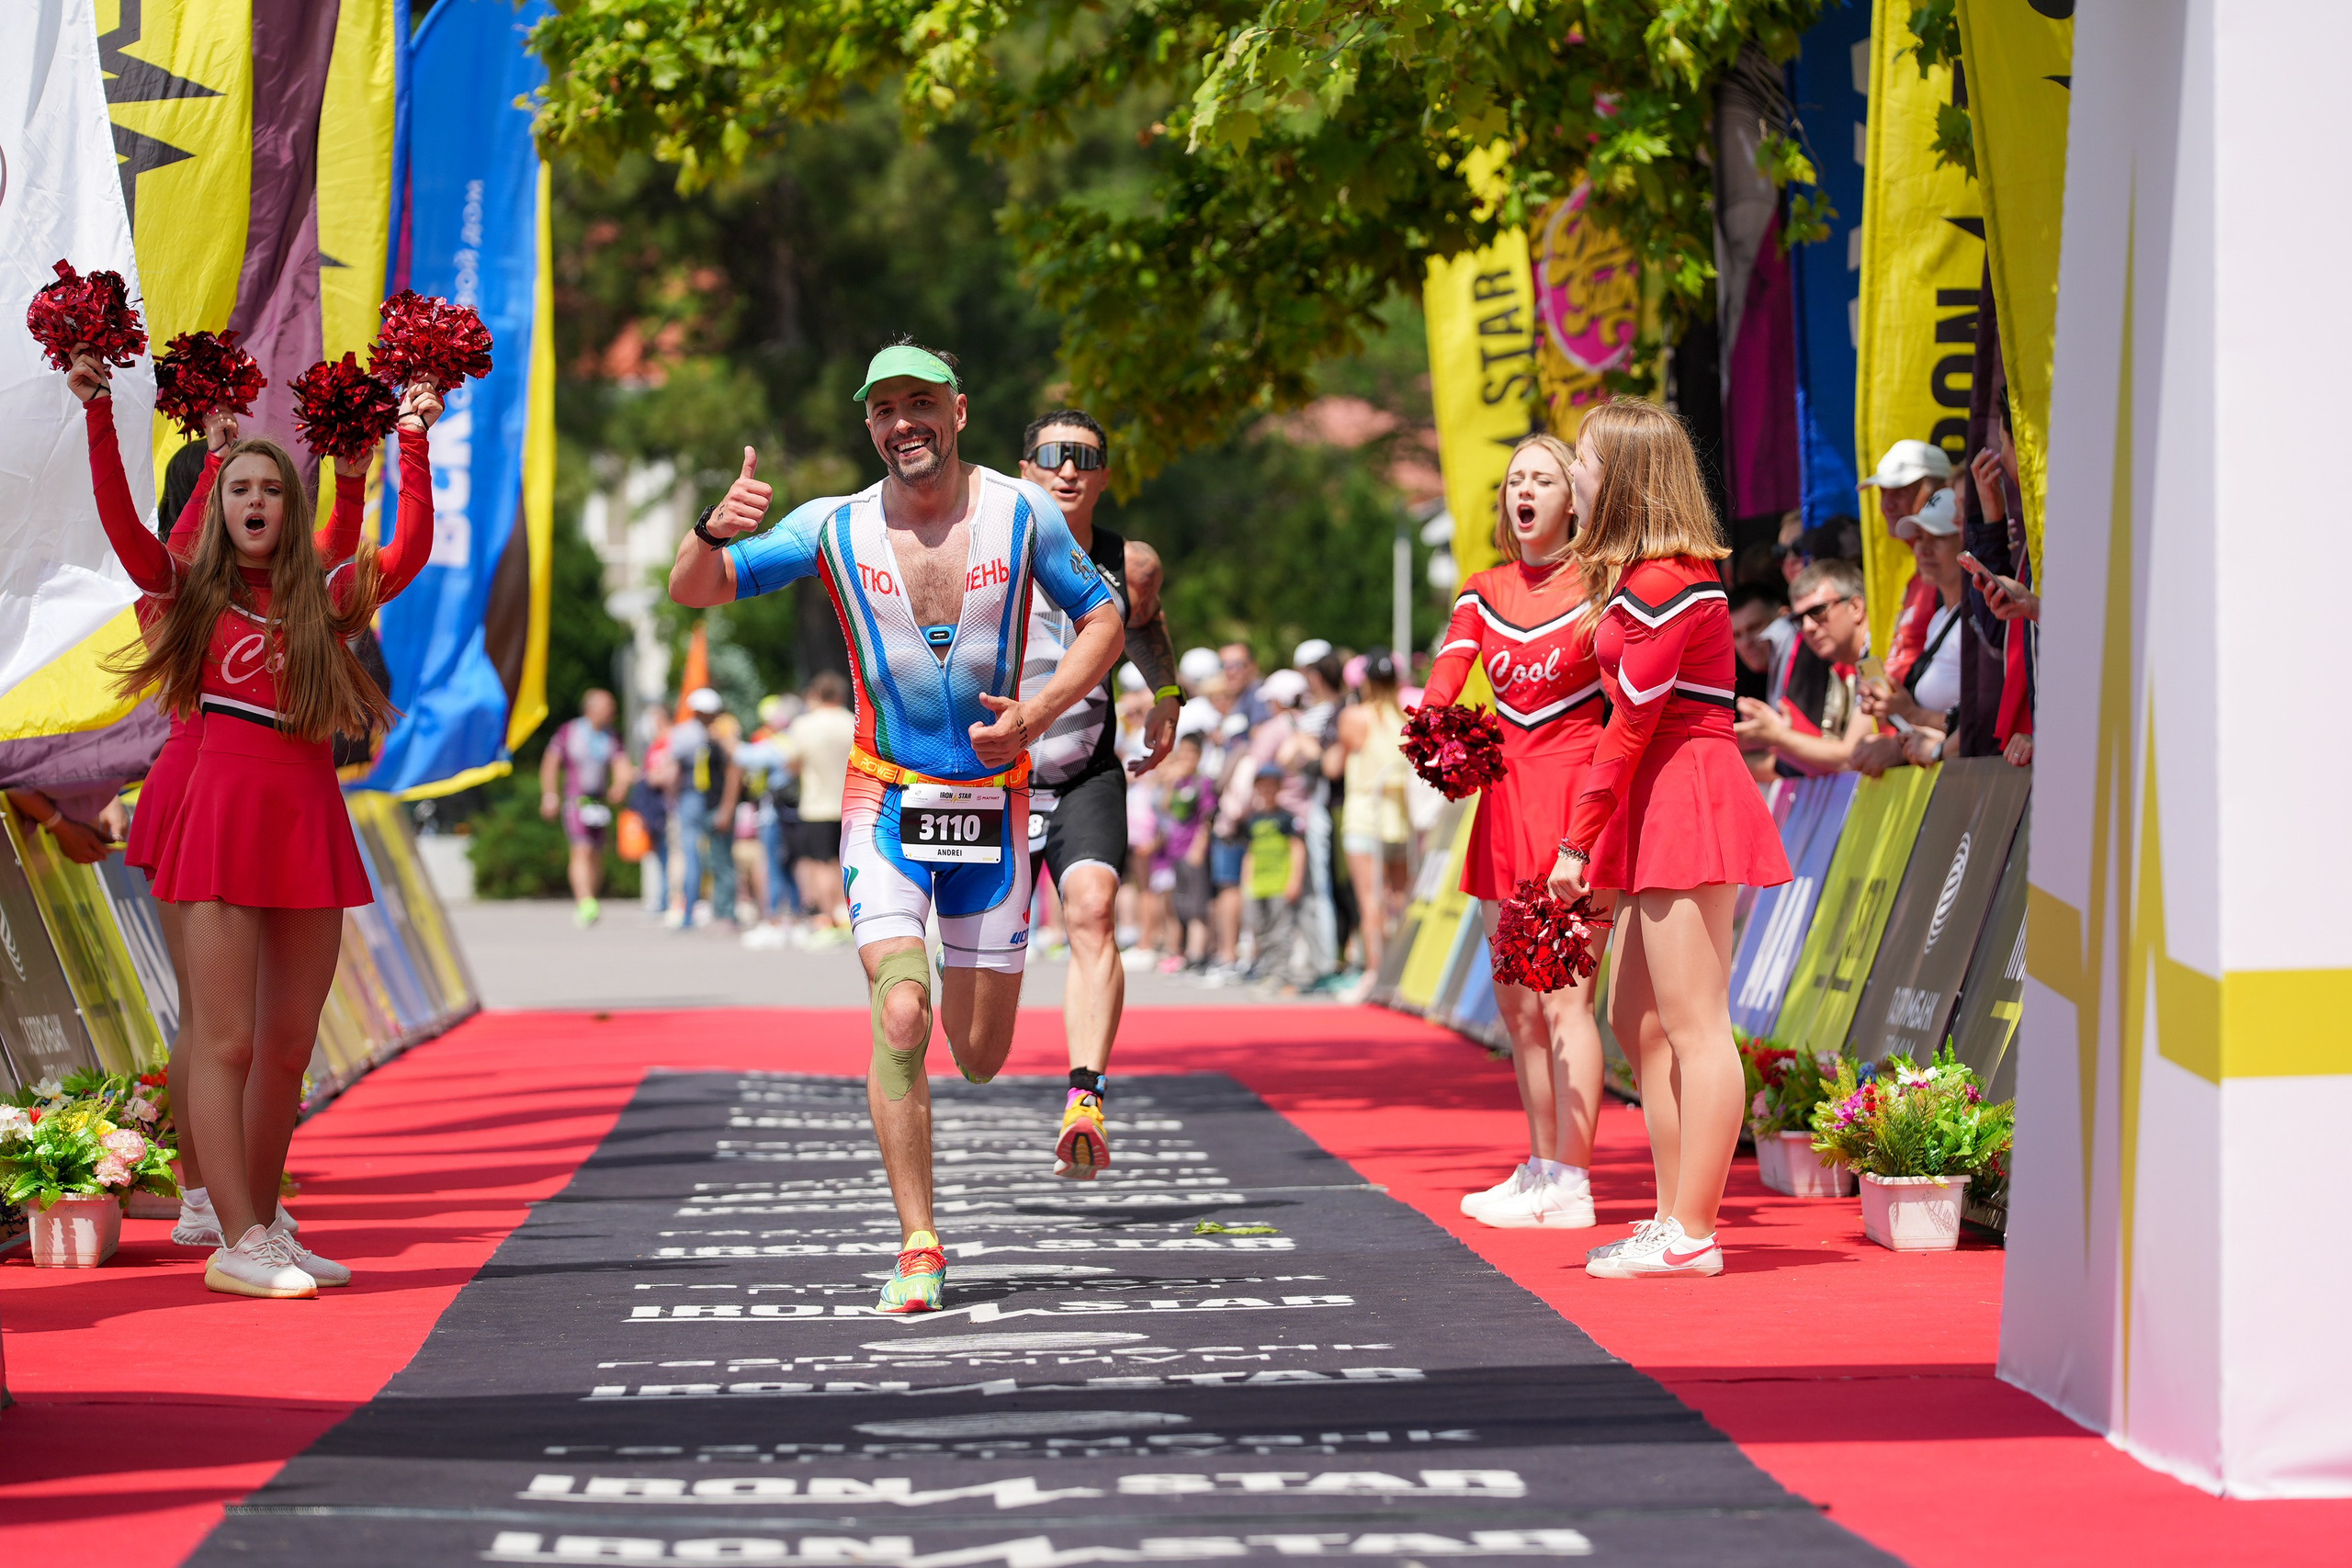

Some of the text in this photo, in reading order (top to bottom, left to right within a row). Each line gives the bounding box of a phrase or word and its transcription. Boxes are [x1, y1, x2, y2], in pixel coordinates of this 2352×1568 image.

[1474, 270, 1535, 405] STAR
[1929, 288, 1982, 466] RON
[221, 633, 286, 685] Co
[1487, 647, 1561, 694] Cool
[1016, 716, 1028, 749] 3110
[919, 814, 980, 841] 3110
[1028, 814, 1045, 838] 8
[1036, 1237, 1296, 1249] STAR
[634, 1275, 1331, 1289] ГАЗПОМБАНК
[748, 1285, 1221, 1294] ПРМИУМ
[1058, 1294, 1355, 1311] STAR
[591, 1367, 1427, 1396] IRON STAR
[528, 1469, 1526, 1497] IRON STAR
[491, 1529, 1592, 1561] IRON STAR
